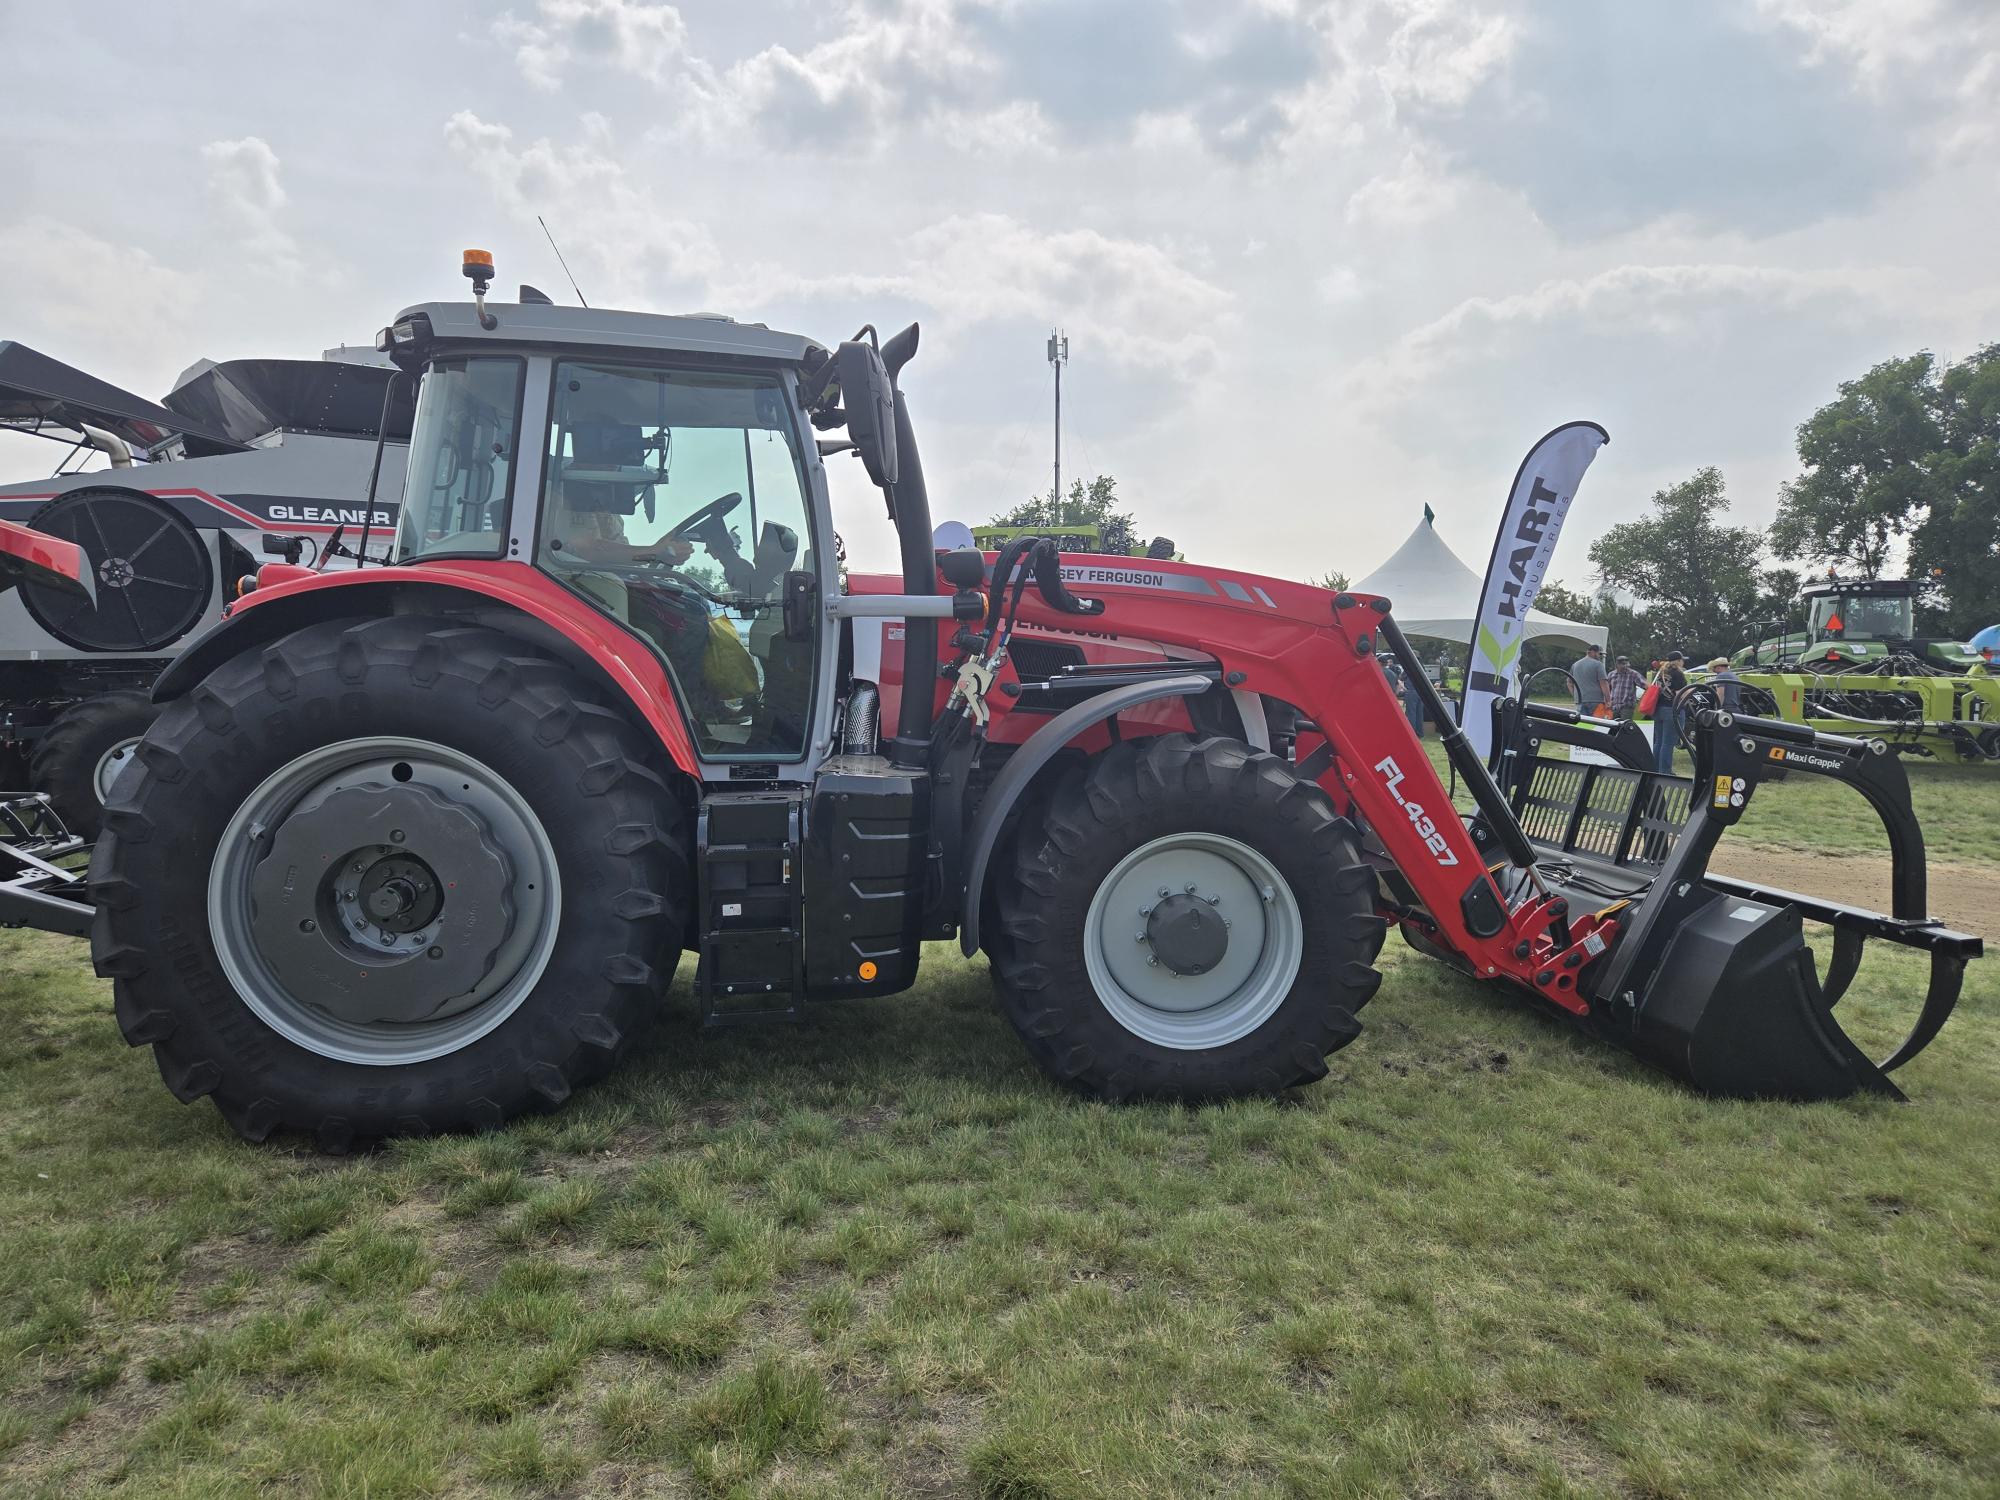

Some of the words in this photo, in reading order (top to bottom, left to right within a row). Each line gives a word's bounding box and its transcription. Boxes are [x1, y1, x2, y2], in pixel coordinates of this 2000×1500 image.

[268, 505, 390, 525] GLEANER
[1517, 496, 1569, 621] INDUSTRIES
[1025, 566, 1084, 581] MSEY
[1088, 570, 1163, 586] FERGUSON
[1786, 751, 1808, 763] Maxi
[1374, 755, 1459, 866] FL.4327
